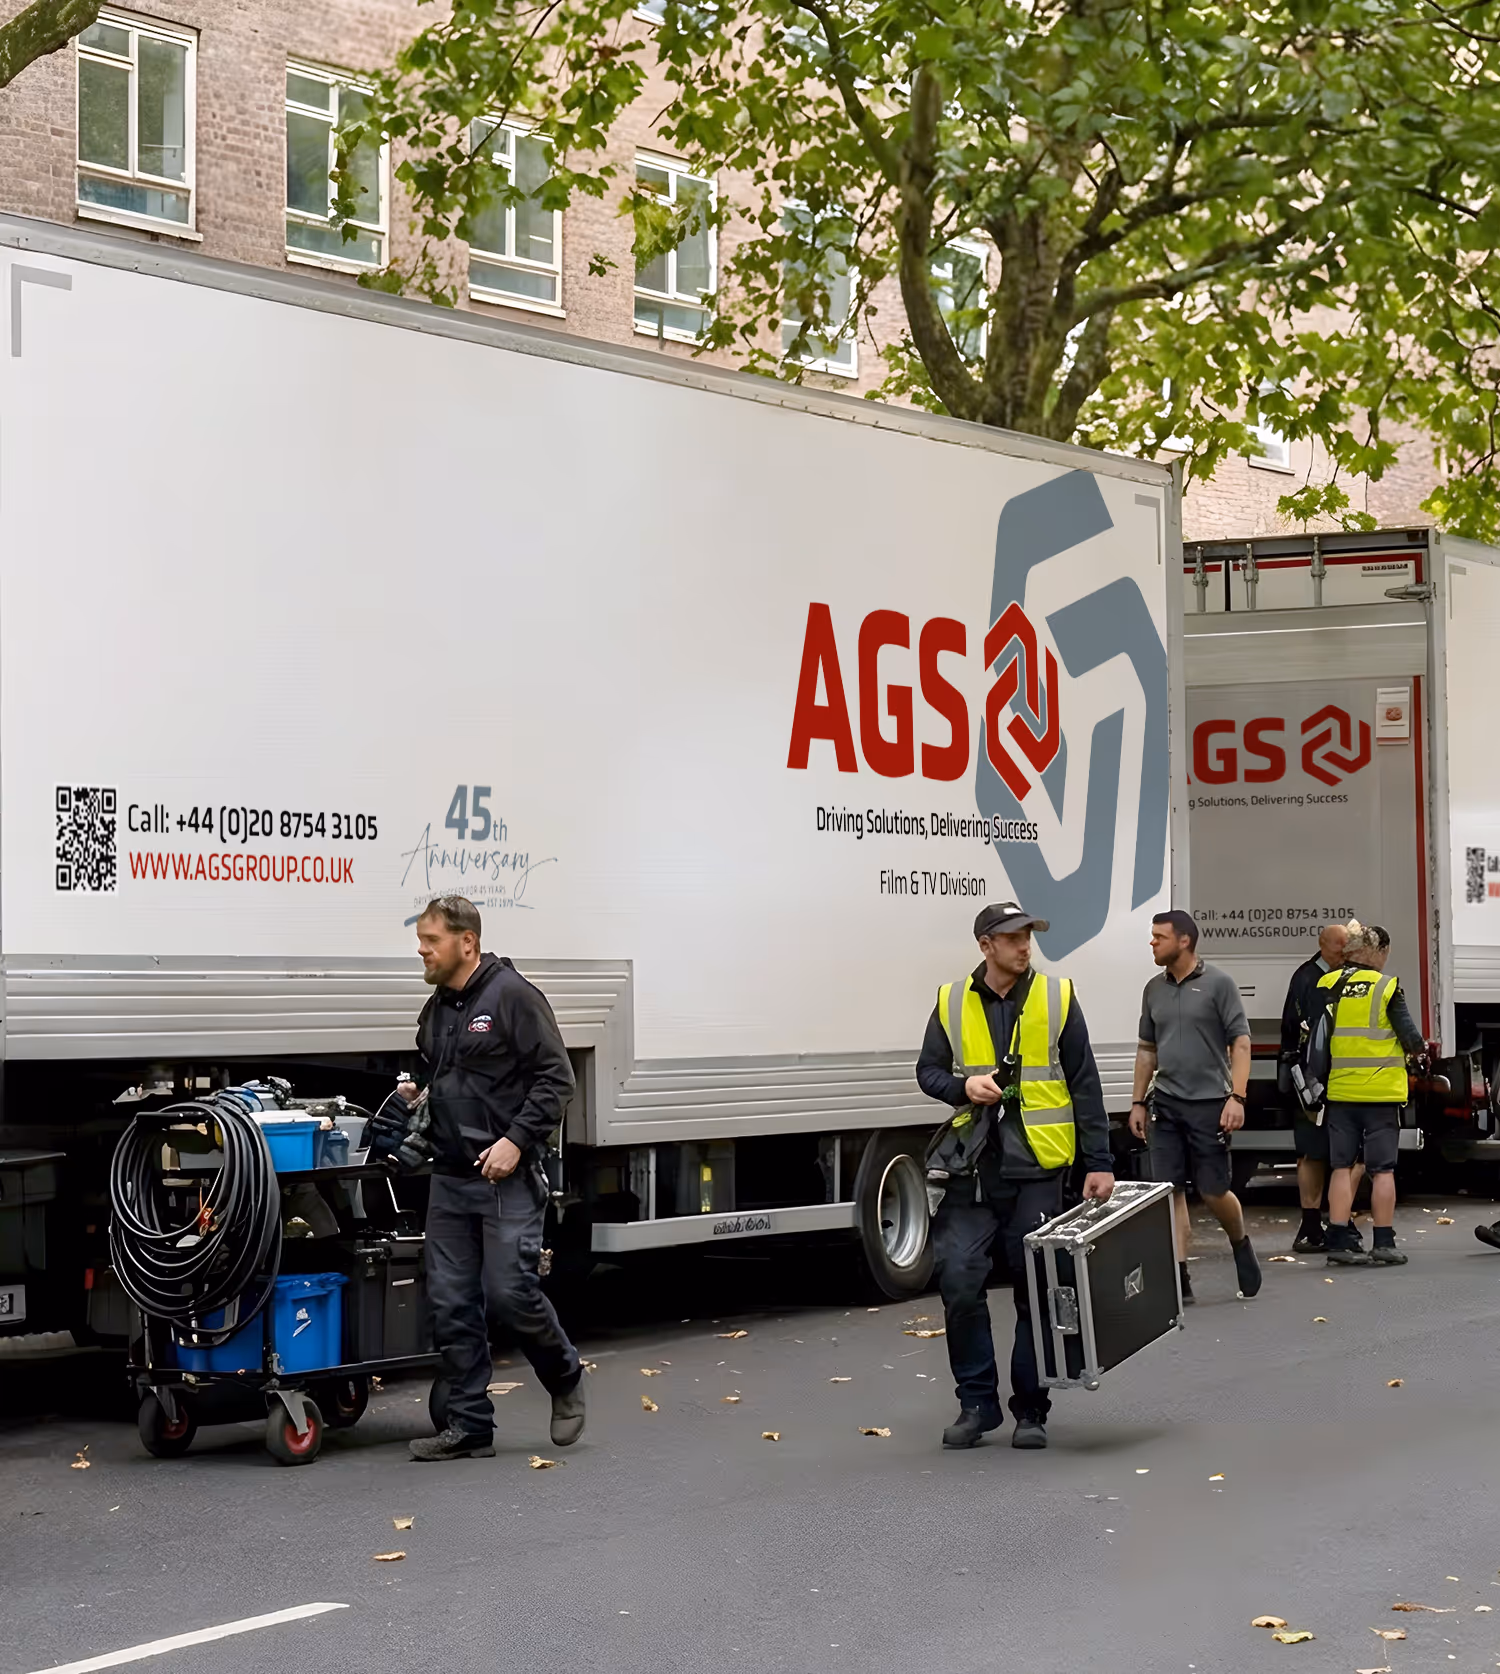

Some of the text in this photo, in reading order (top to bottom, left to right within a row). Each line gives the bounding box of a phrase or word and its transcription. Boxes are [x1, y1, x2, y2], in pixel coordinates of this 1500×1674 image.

[786, 602, 970, 782] AGS
[1187, 717, 1286, 785] GS
[1197, 796, 1249, 808] Solutions,
[1250, 794, 1304, 807] Delivering
[1306, 793, 1349, 804] Success
[128, 803, 378, 844] Call: +44 (0)20 8754 3105
[816, 806, 1039, 846] Driving Solutions, Delivering Success
[128, 851, 355, 884] WWW.AGSGROUP.CO.UK
[400, 822, 557, 900] Anniversary
[880, 869, 986, 897] Film & TV Division
[1193, 907, 1355, 923] Call: +44 (0)20 8754 3105
